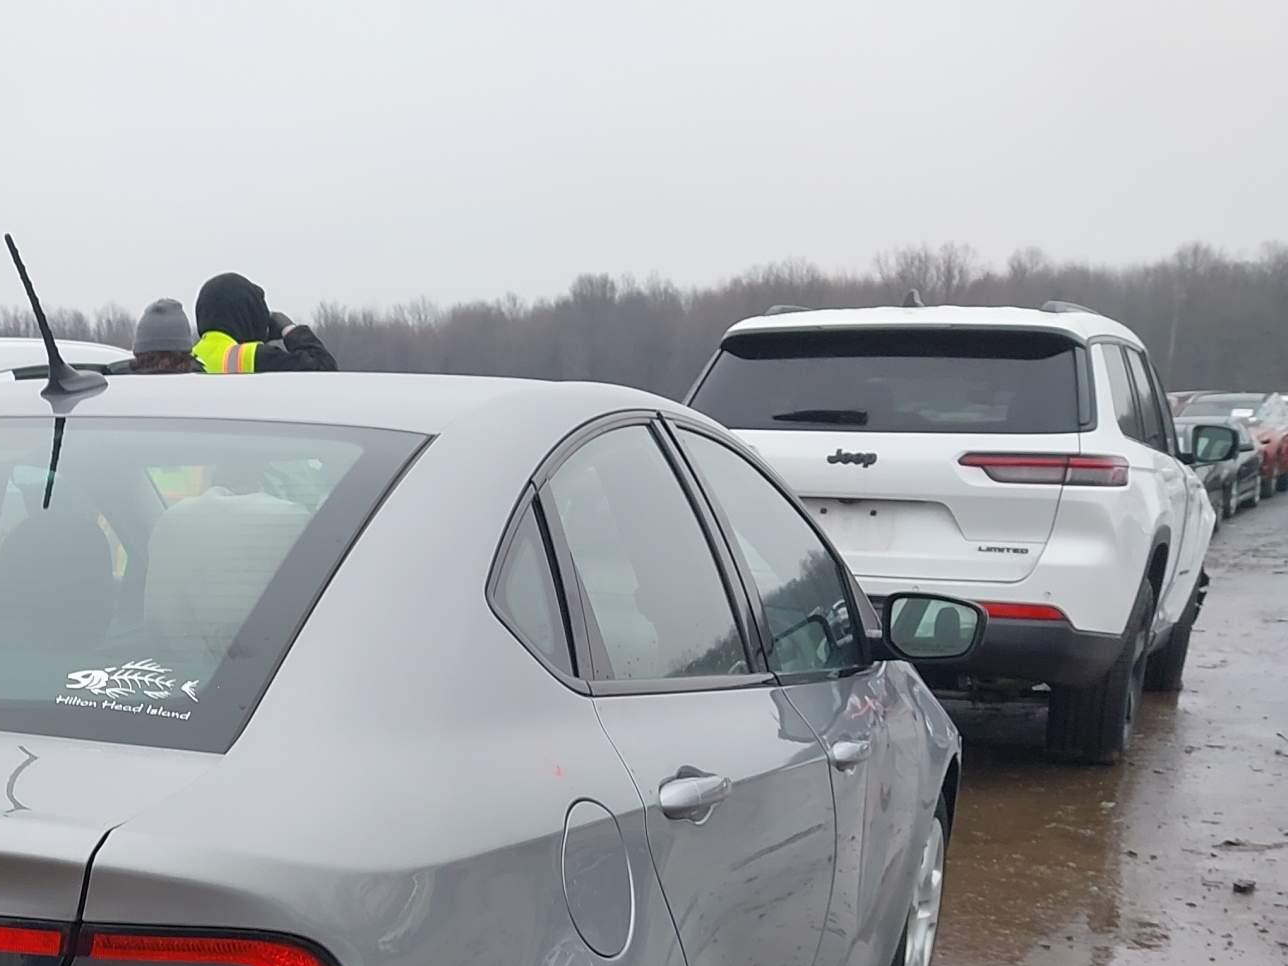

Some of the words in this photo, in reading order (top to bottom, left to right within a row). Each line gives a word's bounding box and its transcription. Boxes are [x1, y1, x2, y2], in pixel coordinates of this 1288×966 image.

[826, 448, 878, 469] Jeep
[978, 545, 1029, 554] LIMITED
[55, 695, 97, 708] Hilton
[101, 700, 144, 713] Head
[146, 705, 191, 720] Island
